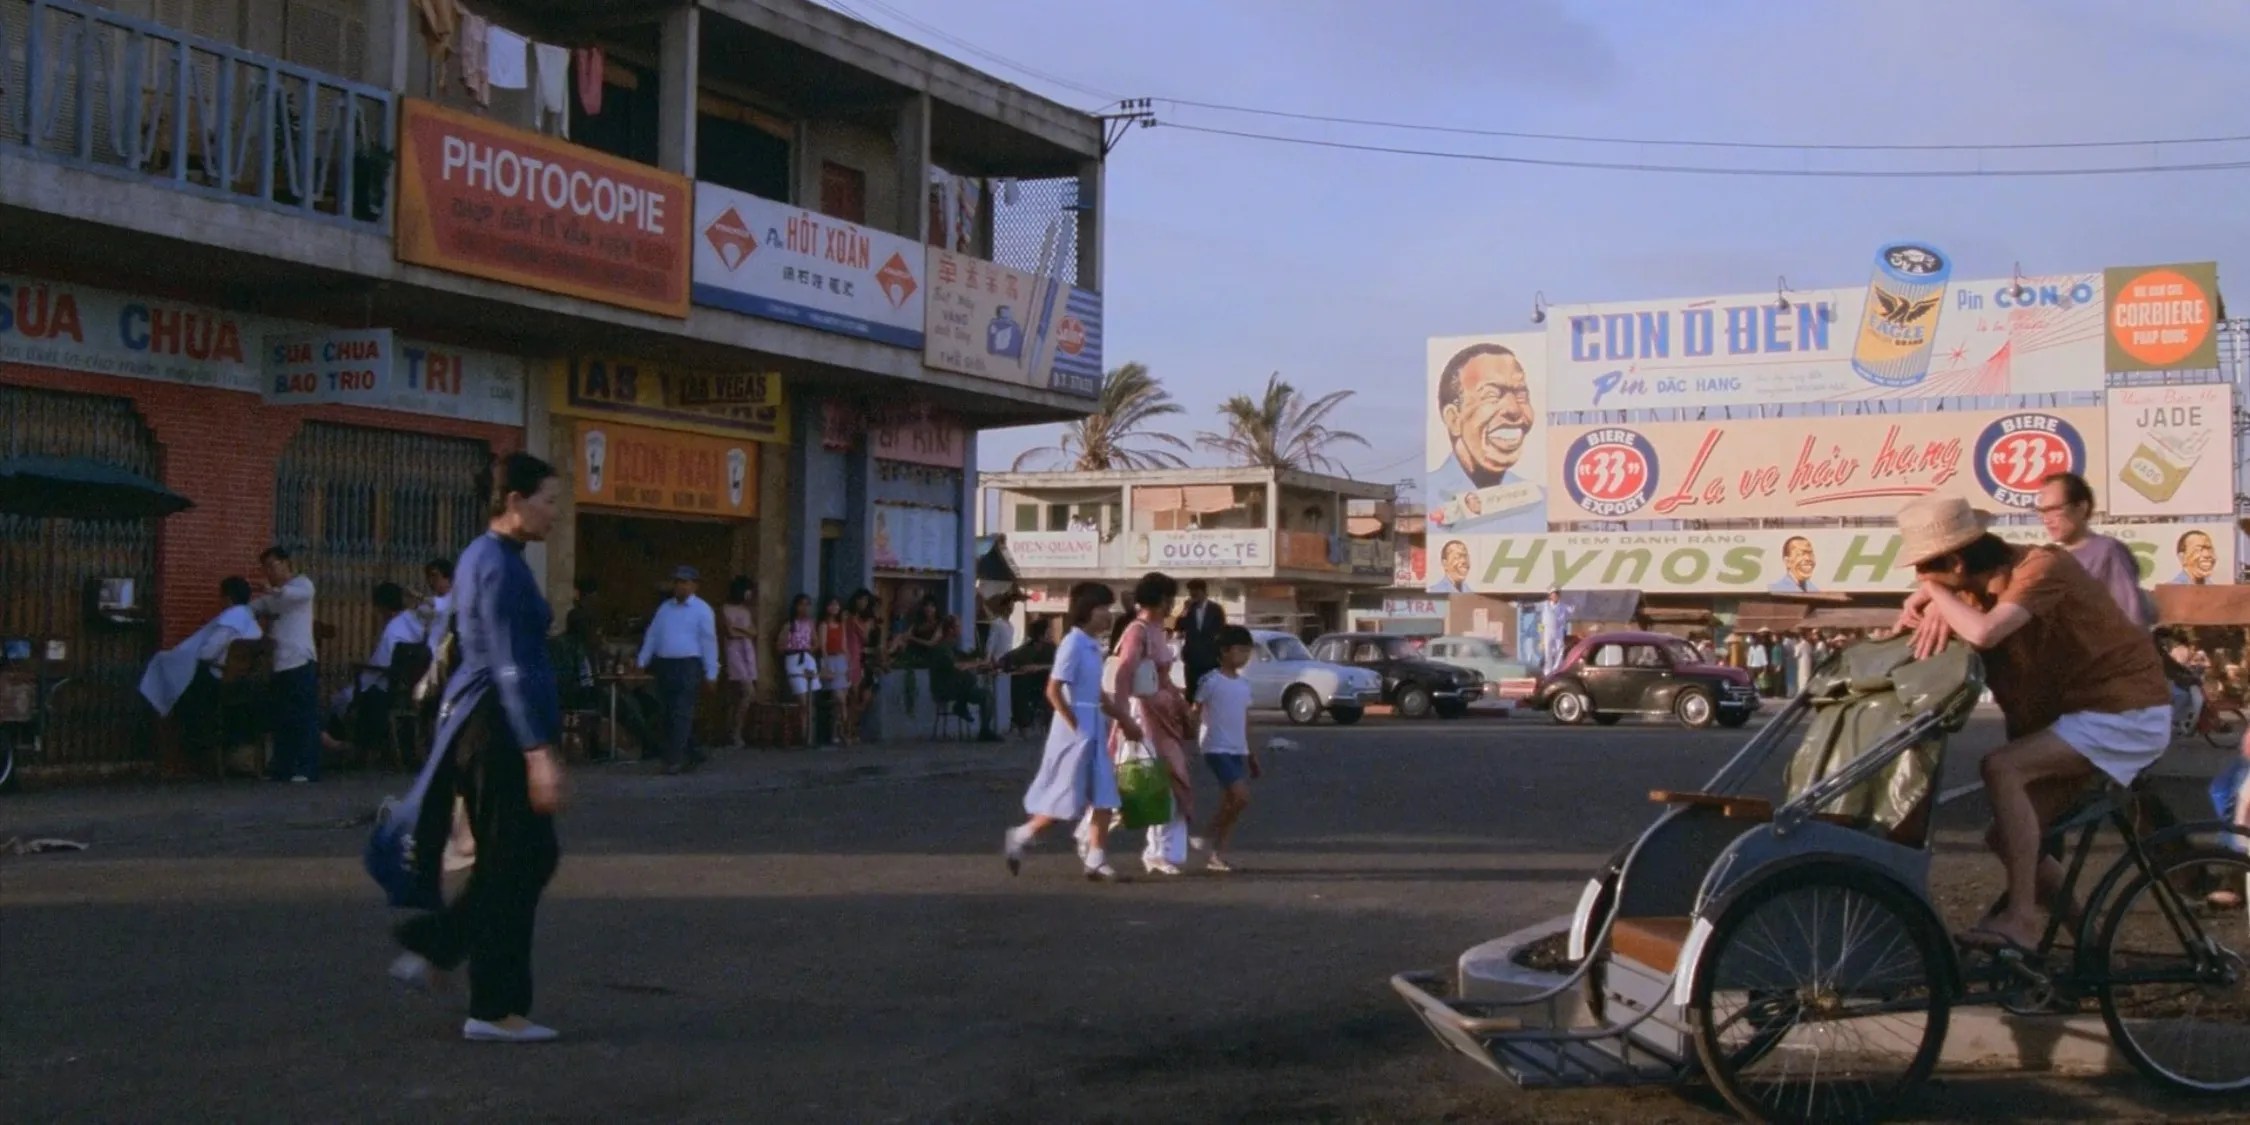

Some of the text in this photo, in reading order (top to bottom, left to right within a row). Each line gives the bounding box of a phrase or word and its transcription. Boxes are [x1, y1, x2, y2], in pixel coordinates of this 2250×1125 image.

[442, 136, 665, 234] PHOTOCOPIE
[1958, 288, 1983, 311] Pin
[1995, 285, 2058, 308] CON
[2115, 299, 2204, 327] CORBIERE
[1568, 311, 1670, 362] CON
[715, 375, 768, 400] VEGAS
[1592, 366, 1648, 406] Pin
[2001, 415, 2058, 434] BIERE
[2136, 406, 2202, 428] JADE
[1586, 430, 1635, 446] BIERE
[1580, 491, 1646, 514] EXPORT
[1567, 536, 1609, 545] KEM
[1482, 536, 1767, 590] Hynos
